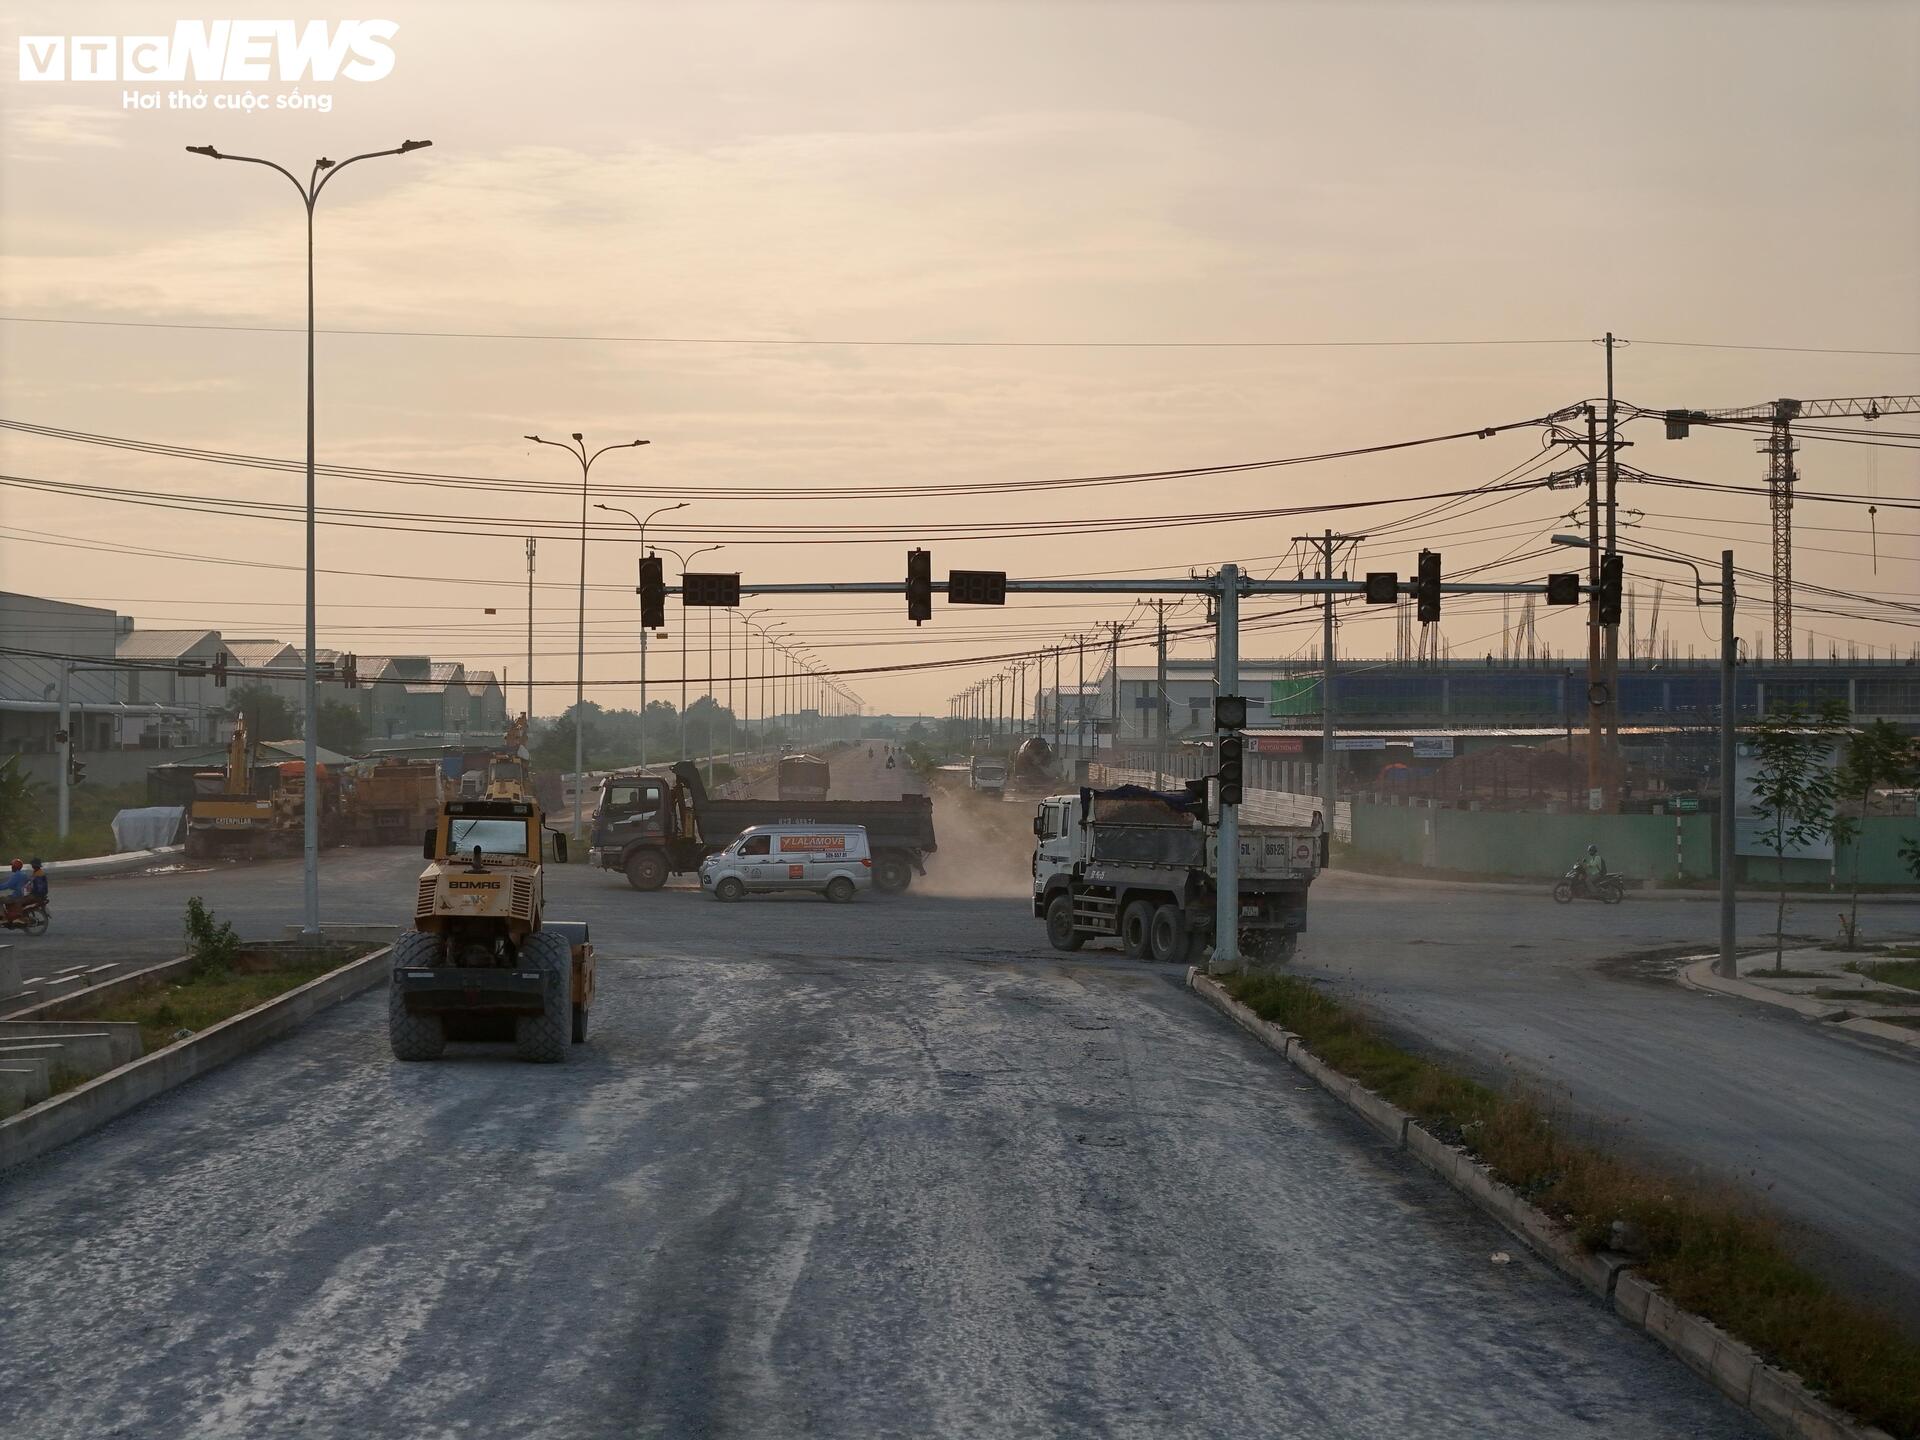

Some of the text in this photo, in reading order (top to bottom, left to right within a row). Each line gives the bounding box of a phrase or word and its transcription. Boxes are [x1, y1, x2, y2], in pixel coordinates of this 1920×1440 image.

[215, 817, 252, 826] CATERPILLAR
[791, 837, 844, 846] LALAMOVE
[448, 881, 501, 889] BOMAG
